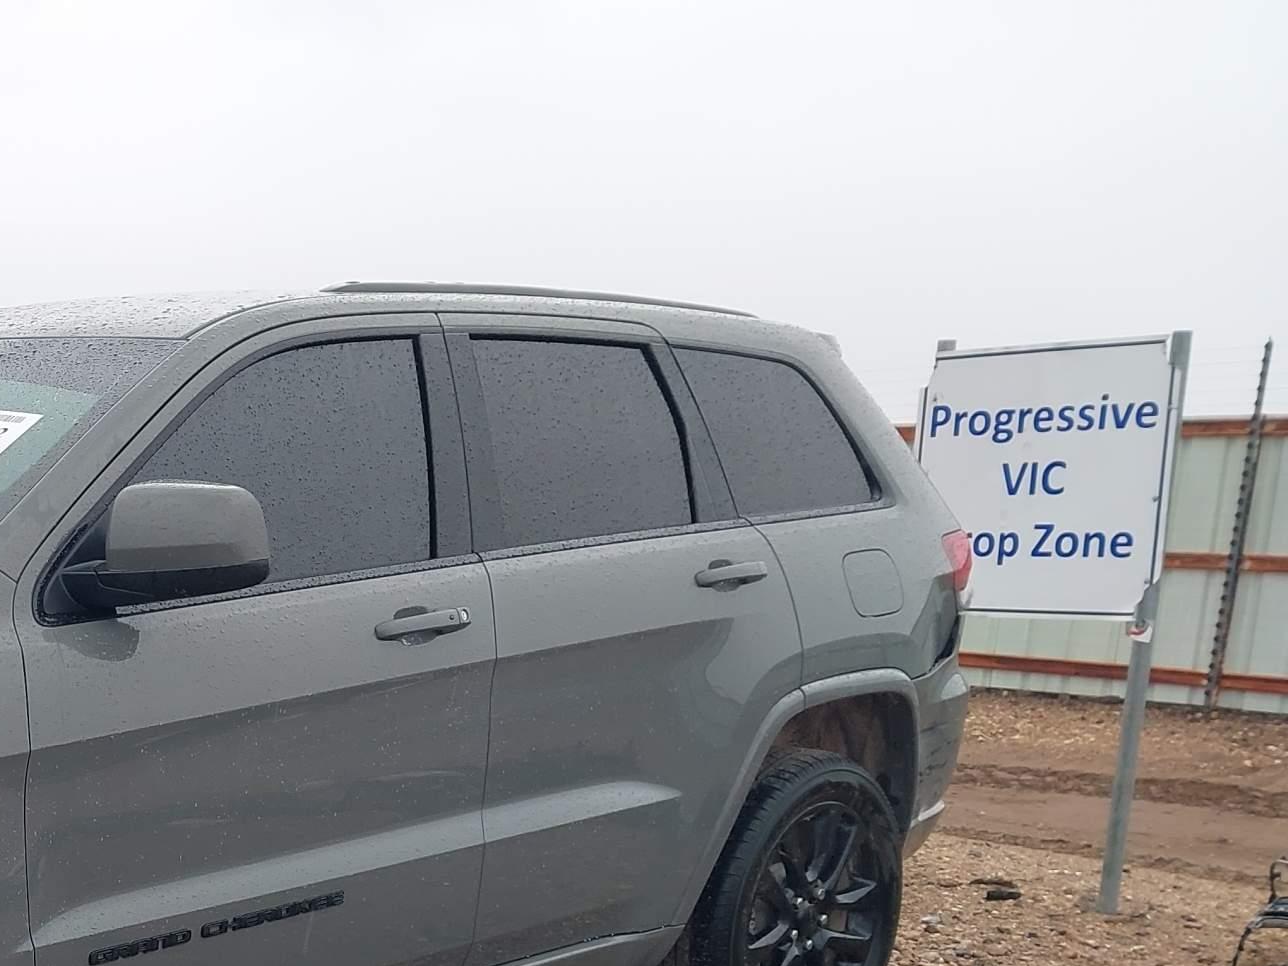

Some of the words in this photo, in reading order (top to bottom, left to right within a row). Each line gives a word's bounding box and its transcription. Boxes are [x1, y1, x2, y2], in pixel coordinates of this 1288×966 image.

[929, 394, 1159, 443] Progressive
[1002, 461, 1066, 496] VIC
[967, 531, 1019, 566] op
[1031, 524, 1133, 558] Zone
[89, 929, 192, 966] GRAND
[200, 890, 344, 938] CHEROKEE
